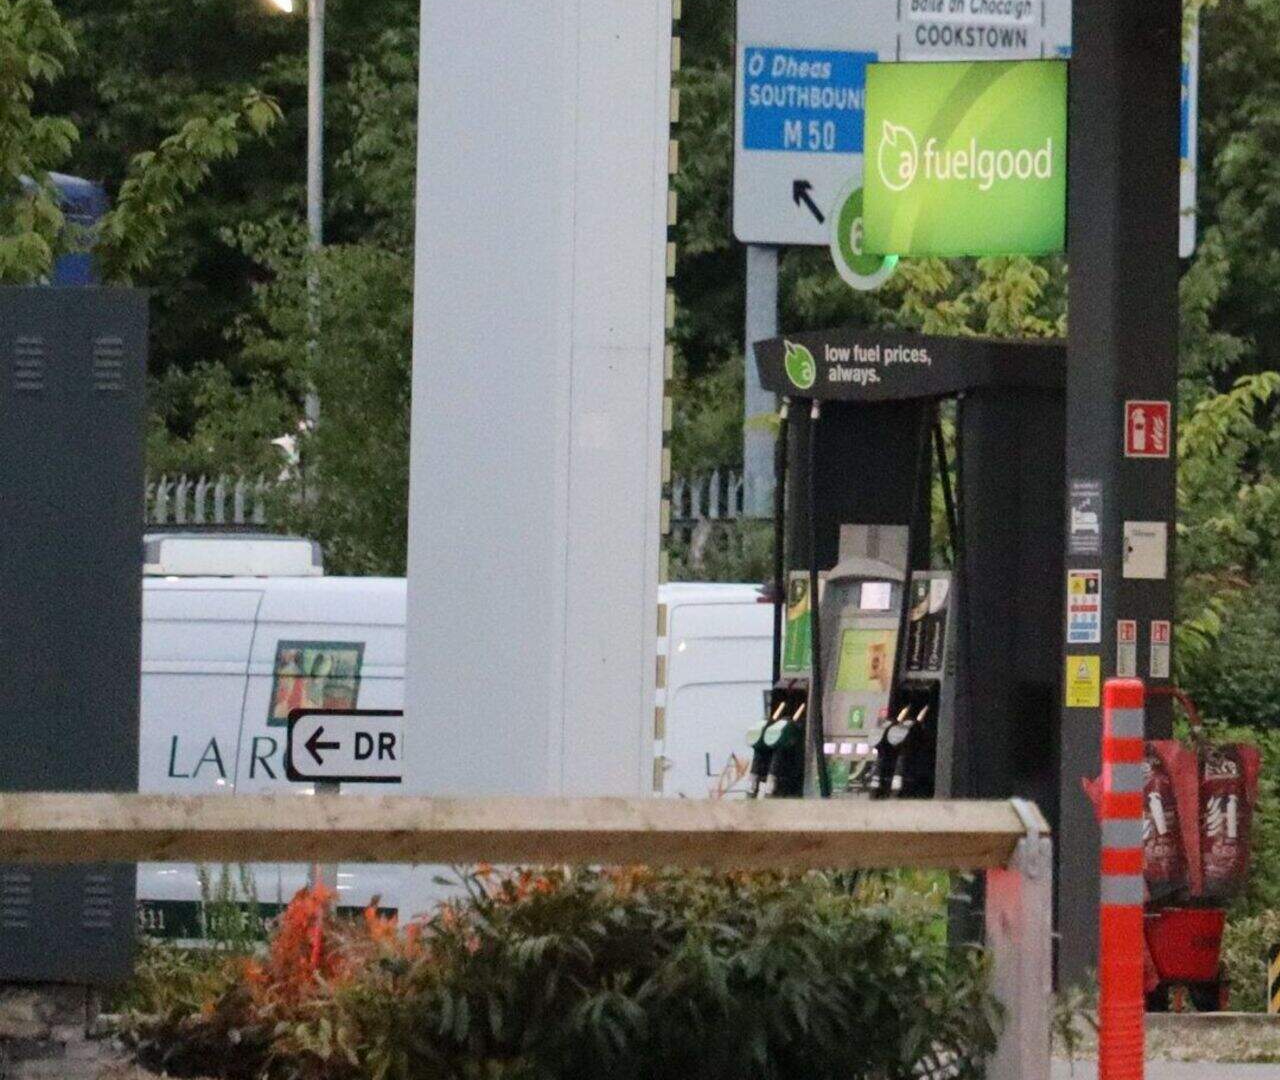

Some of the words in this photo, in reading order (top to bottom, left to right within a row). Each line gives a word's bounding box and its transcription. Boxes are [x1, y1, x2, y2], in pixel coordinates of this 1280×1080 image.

[915, 25, 1028, 48] COOKSTOWN
[771, 54, 832, 79] Dheas
[749, 83, 867, 110] SOUTHBOUN
[923, 137, 1053, 191] fuelgood
[824, 343, 850, 362] low
[854, 344, 880, 362] fuel
[884, 345, 932, 367] prices,
[829, 365, 881, 387] always.
[167, 734, 228, 779] LA
[353, 731, 404, 761] DR
